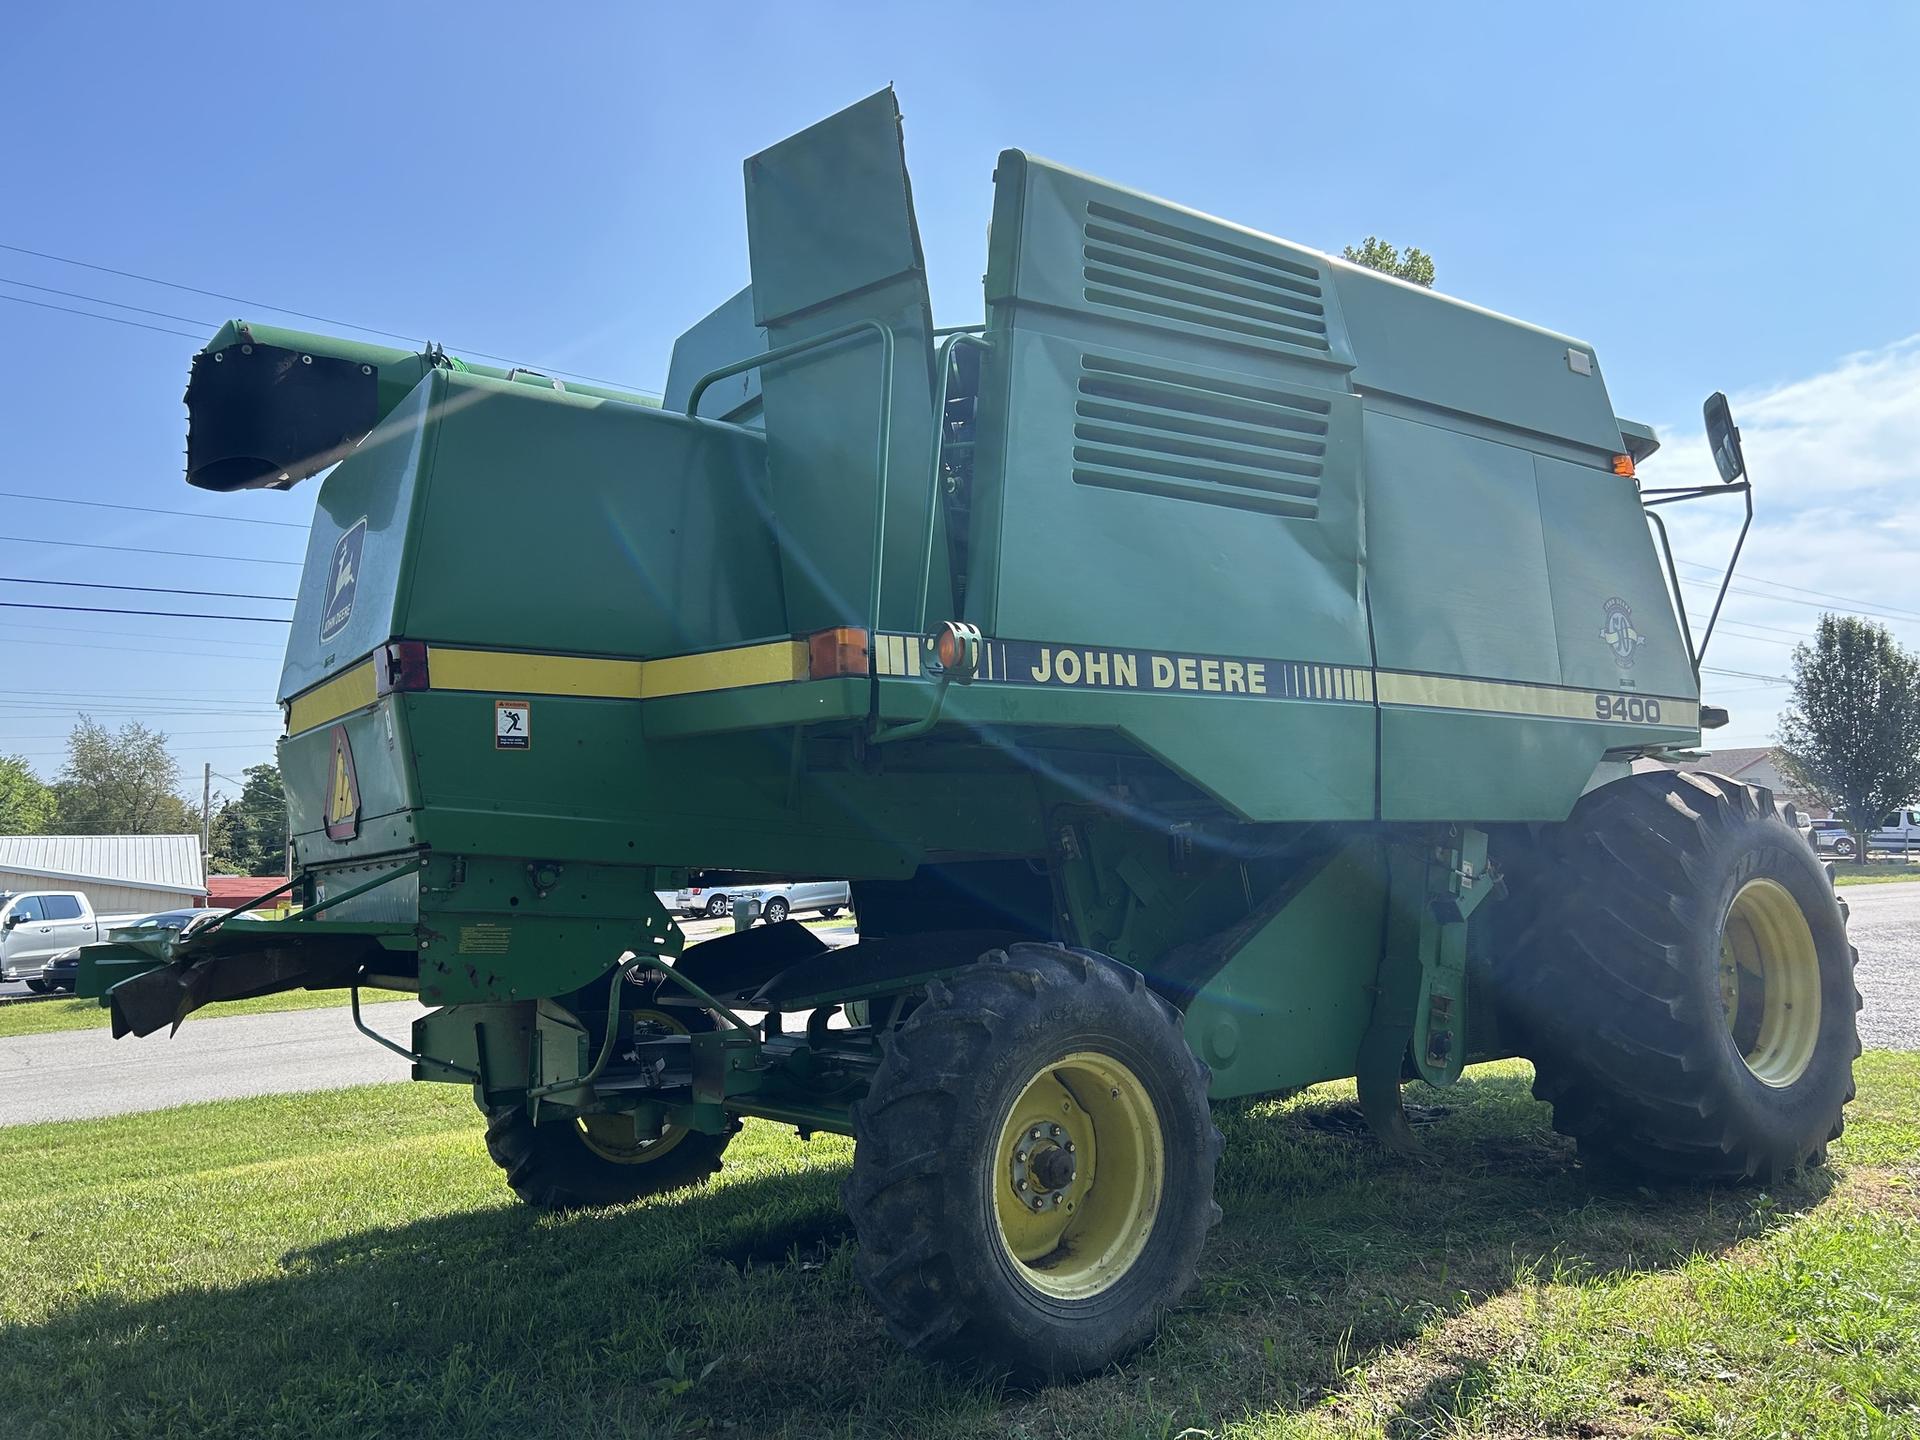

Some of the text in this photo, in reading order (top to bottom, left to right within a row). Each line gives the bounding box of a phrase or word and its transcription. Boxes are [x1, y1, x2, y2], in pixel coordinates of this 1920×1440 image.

[1031, 648, 1267, 694] JOHN DEERE
[1595, 694, 1661, 724] 9400
